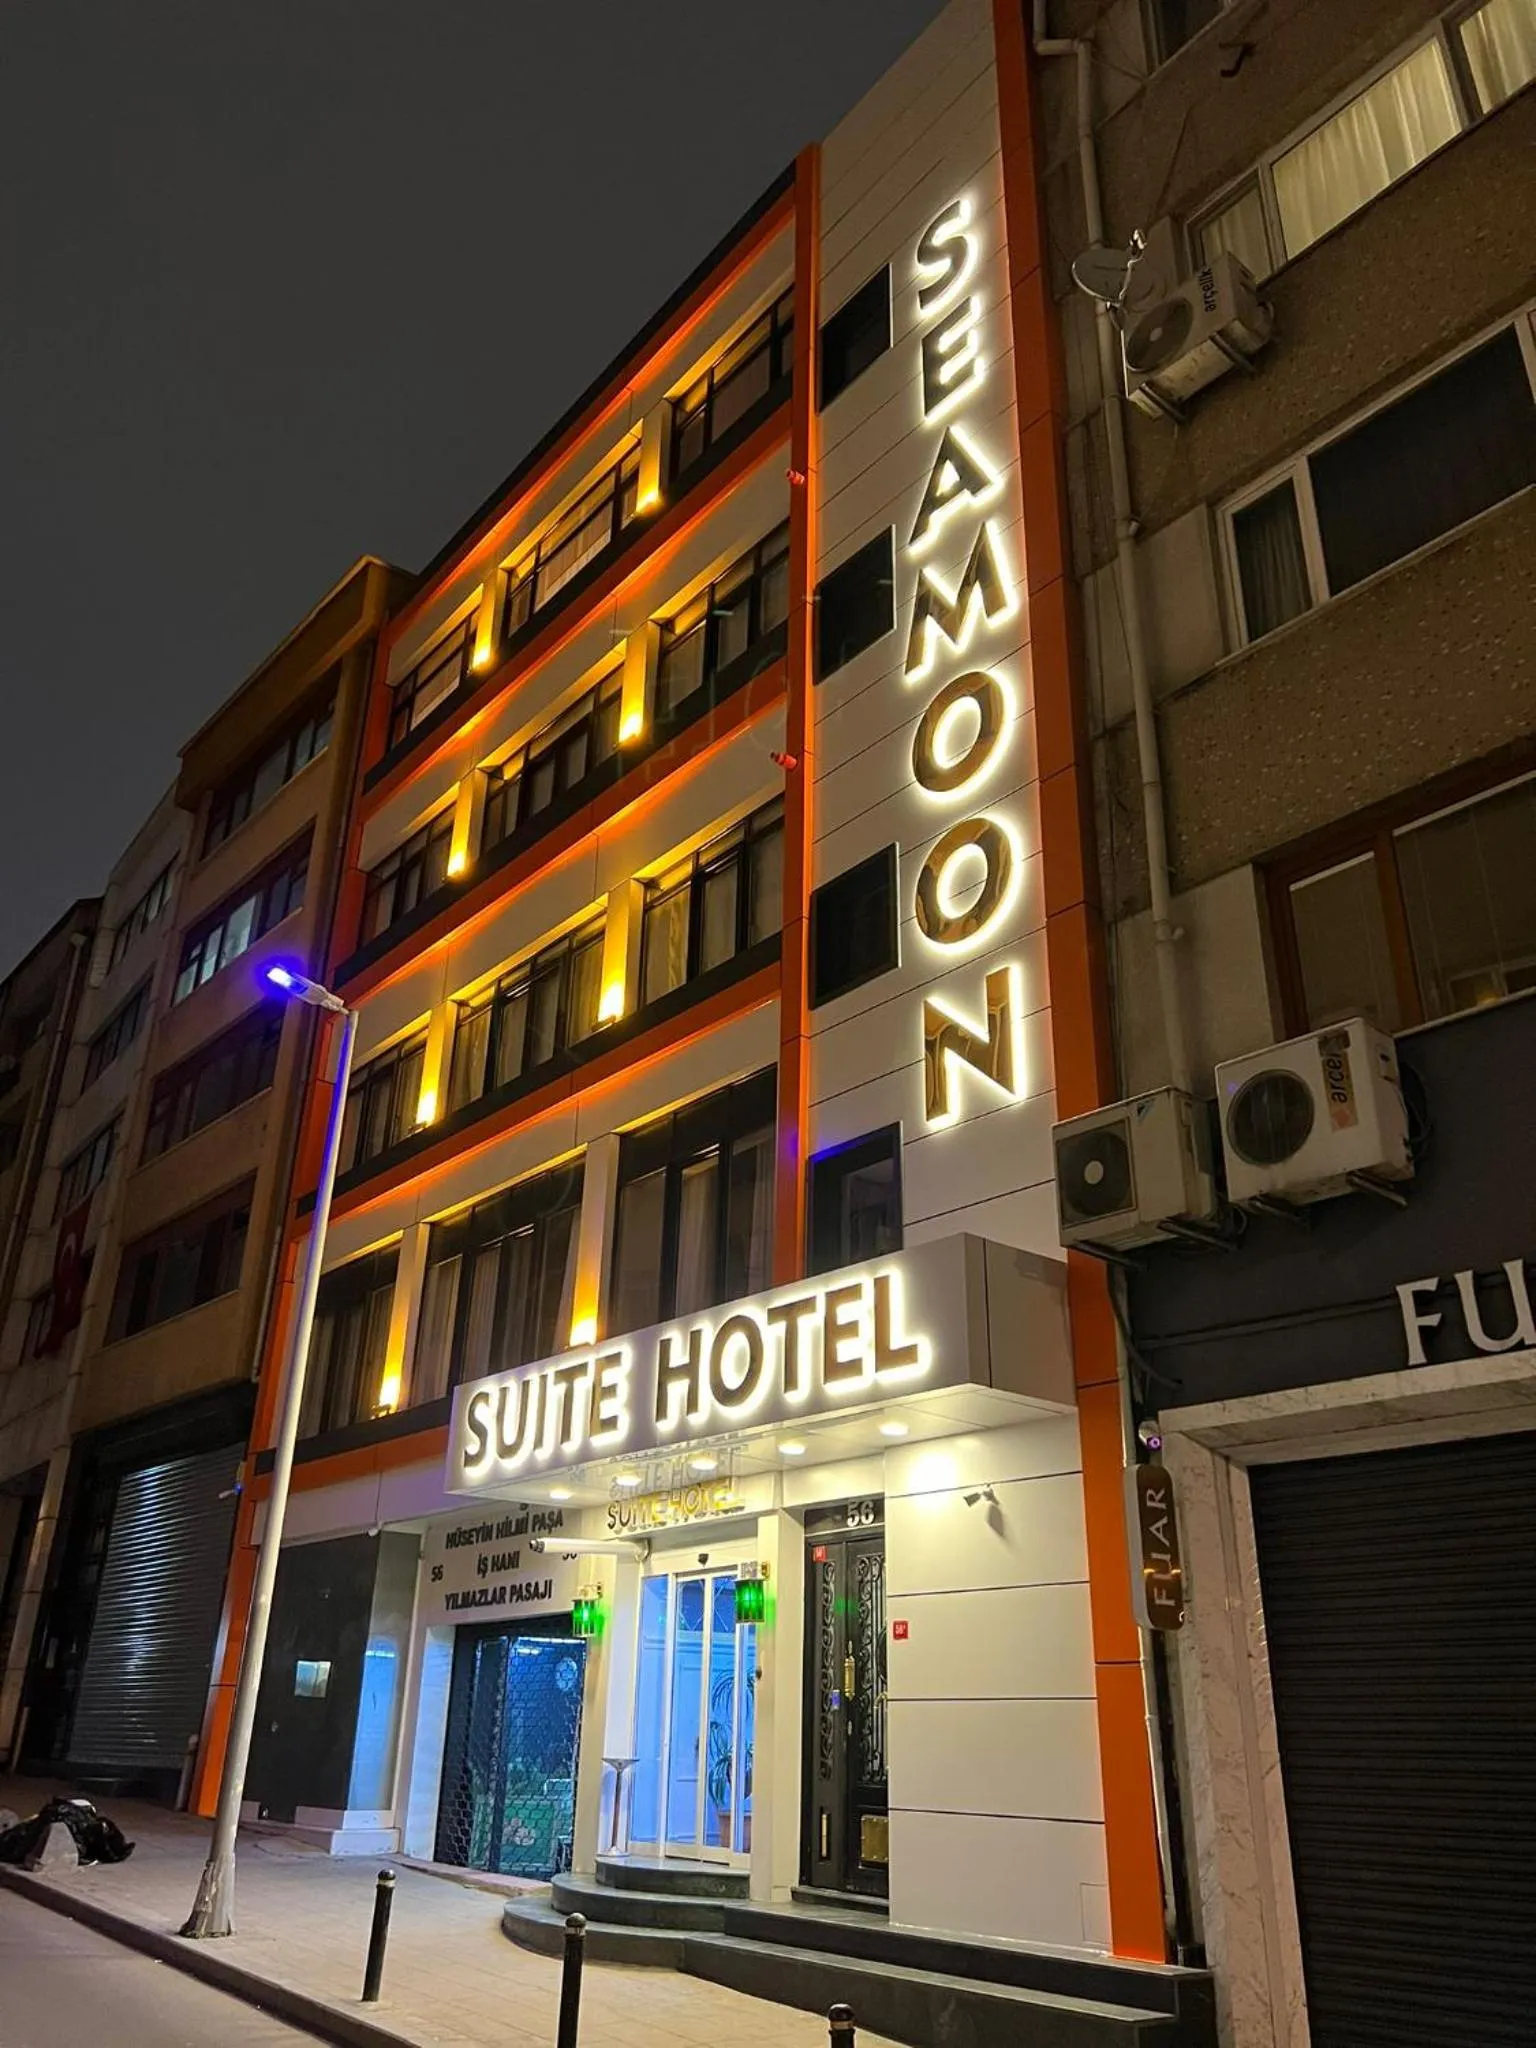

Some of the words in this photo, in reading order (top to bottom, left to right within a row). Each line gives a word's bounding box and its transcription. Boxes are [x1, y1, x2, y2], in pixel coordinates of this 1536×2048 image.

[906, 198, 1023, 1127] SEAMOON
[462, 1347, 630, 1473] SUITE
[655, 1271, 925, 1428] HOTEL
[445, 1521, 494, 1550] HÜSEYİN
[495, 1513, 530, 1540] HİLMİ
[531, 1509, 564, 1535] PAŞA
[846, 1500, 875, 1527] 56
[476, 1554, 489, 1579] İŞ
[490, 1550, 521, 1573] HANI
[445, 1584, 507, 1611] YILMAZLAR
[509, 1579, 553, 1604] PASAJI
